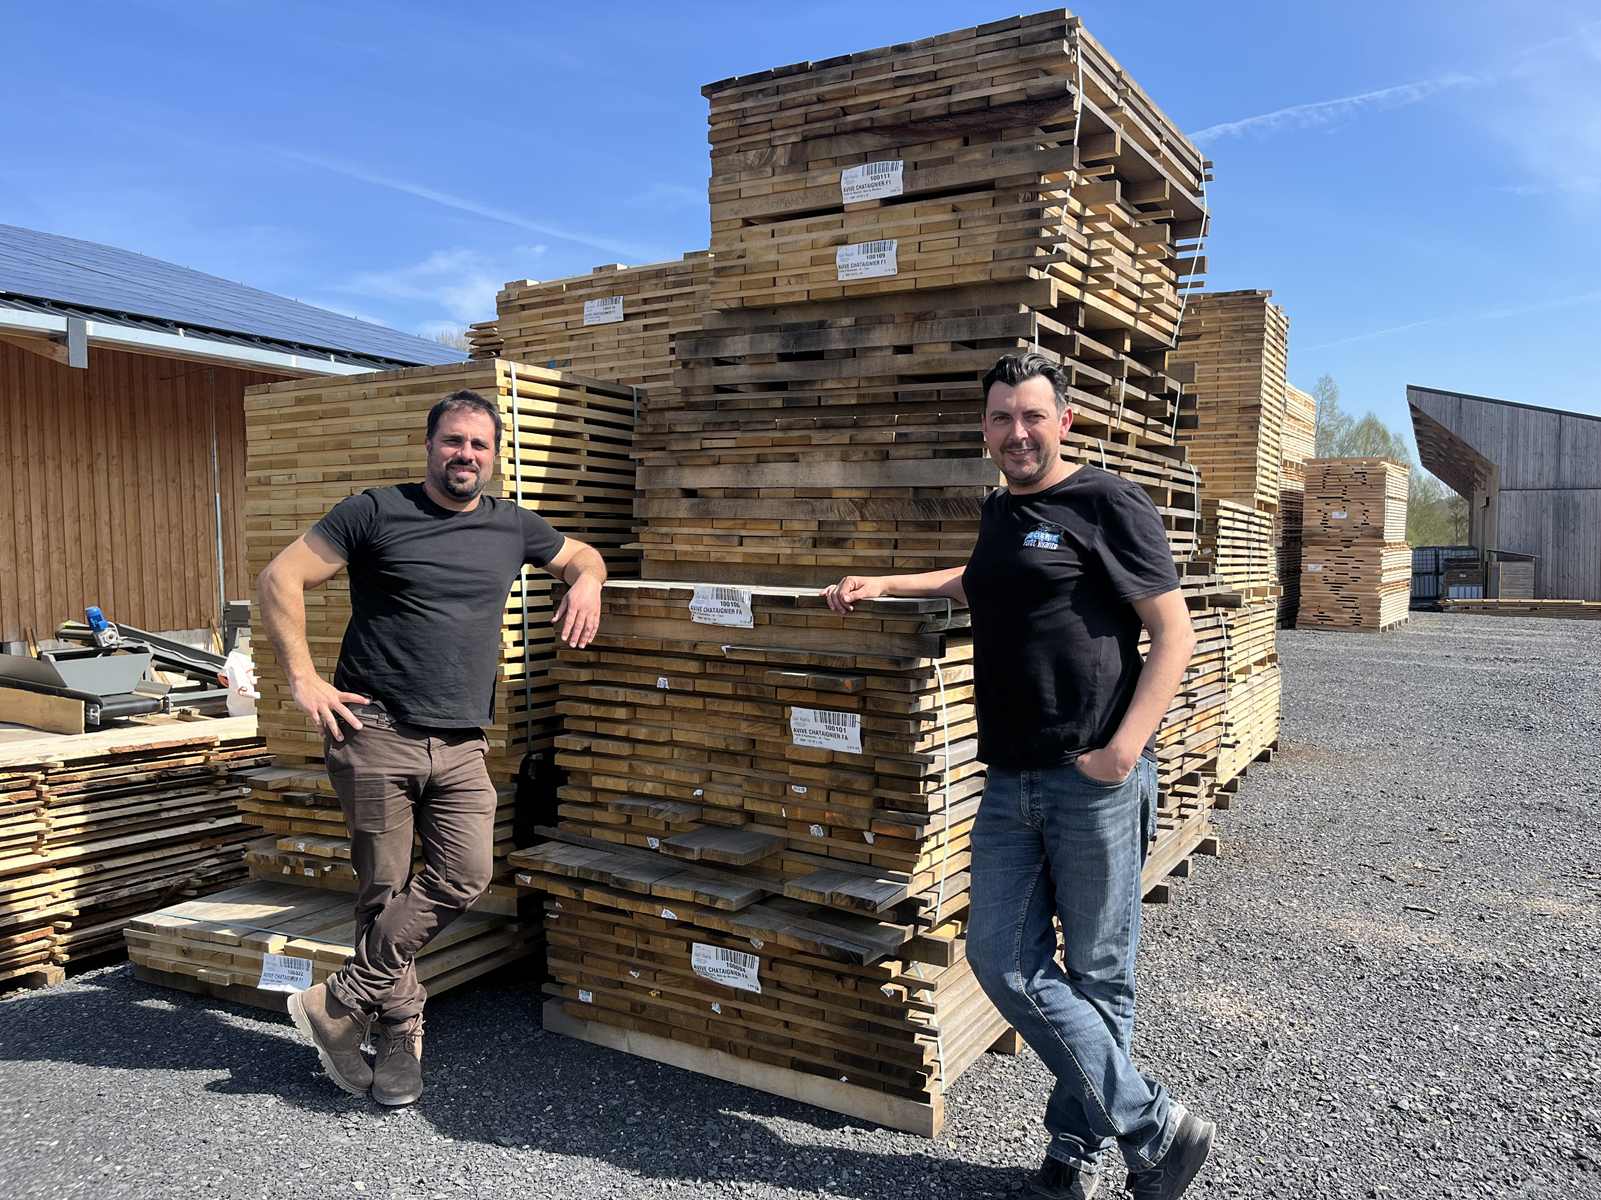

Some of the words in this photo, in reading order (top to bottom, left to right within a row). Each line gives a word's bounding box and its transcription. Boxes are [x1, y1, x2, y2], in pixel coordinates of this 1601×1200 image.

[808, 728, 840, 740] CHATAIGNIER
[824, 724, 846, 734] 100101
[708, 966, 742, 977] CHATAIGNIER
